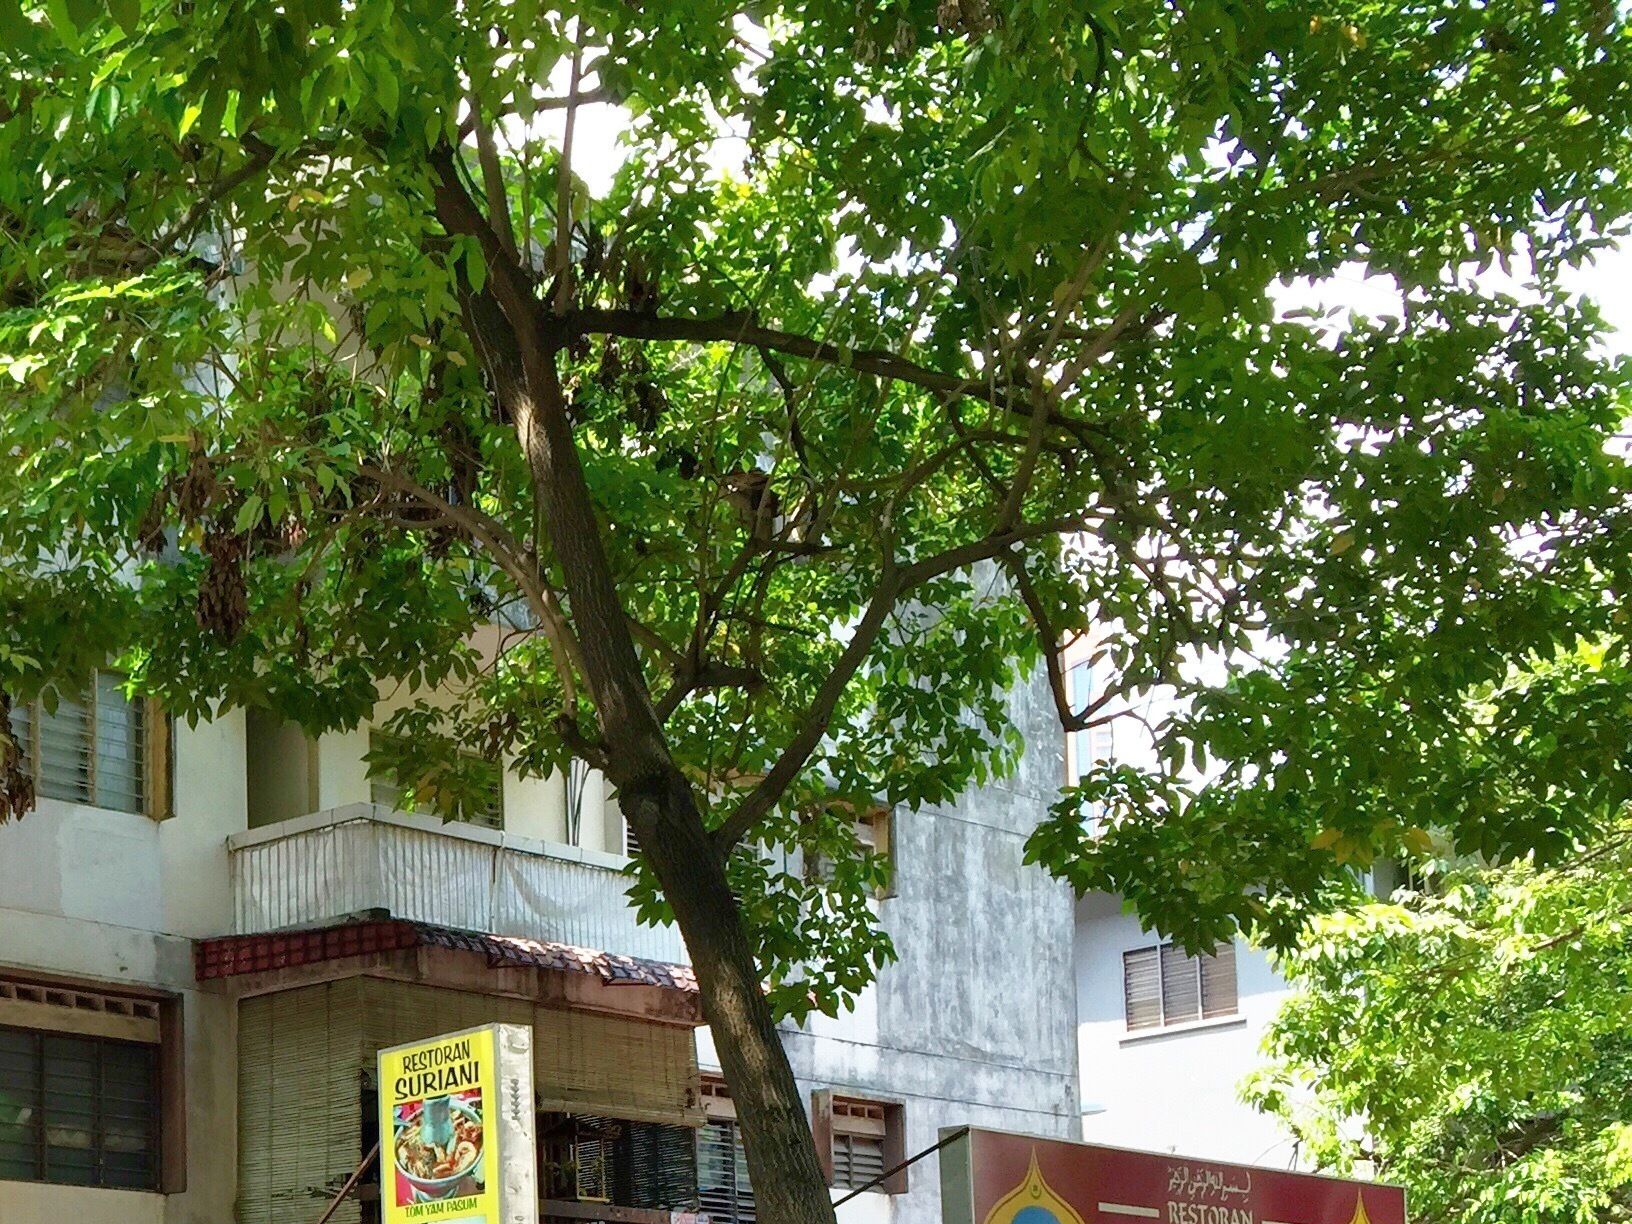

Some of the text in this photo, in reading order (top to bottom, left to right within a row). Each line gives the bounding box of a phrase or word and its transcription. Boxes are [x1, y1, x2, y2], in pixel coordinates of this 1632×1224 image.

[402, 1040, 471, 1074] RESTORAN
[395, 1061, 480, 1101] SURIANI
[405, 1206, 423, 1218] TOM
[426, 1202, 445, 1216] YAM
